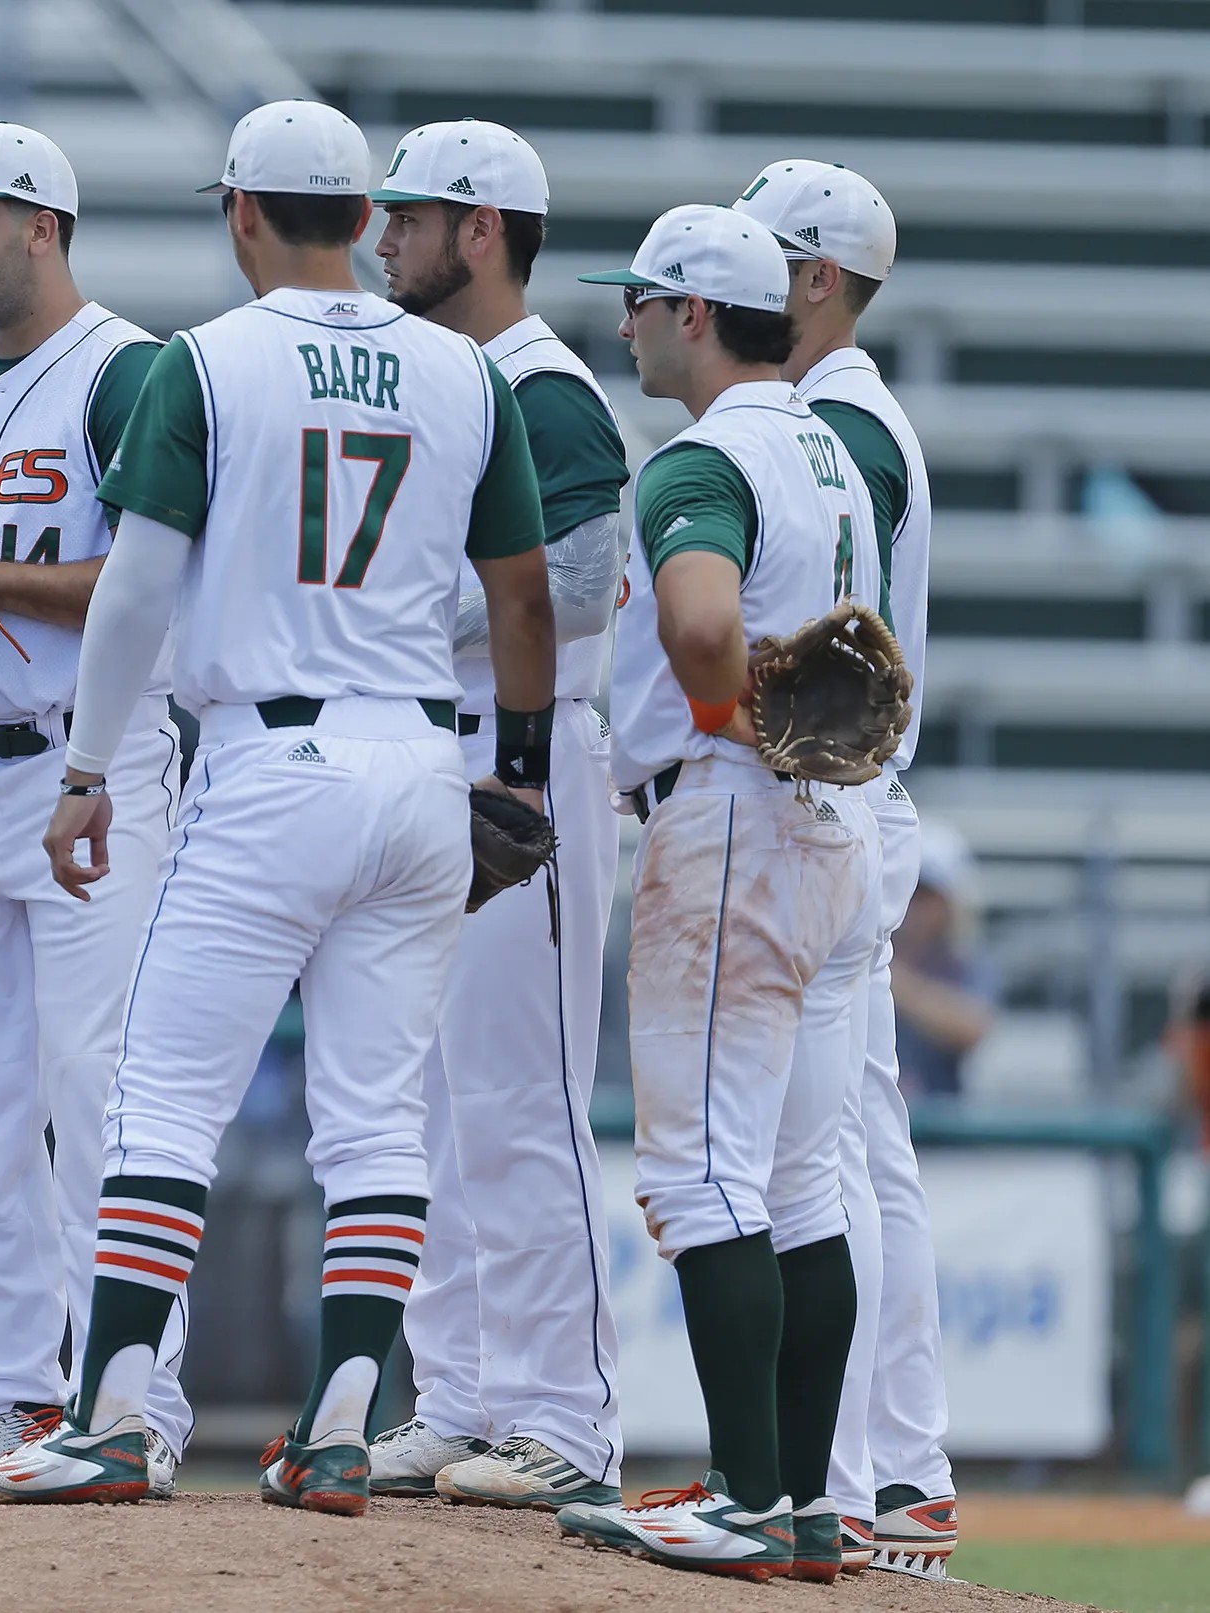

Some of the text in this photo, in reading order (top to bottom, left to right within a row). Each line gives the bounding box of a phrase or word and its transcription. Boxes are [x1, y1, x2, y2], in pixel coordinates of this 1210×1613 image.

[309, 174, 351, 186] miami
[446, 185, 476, 197] adidas
[794, 231, 821, 248] adidas
[661, 270, 686, 283] adidas
[327, 302, 358, 314] ACC
[296, 343, 400, 411] BARR
[297, 427, 412, 589] 17
[286, 752, 327, 764] adidas
[100, 1447, 147, 1468] adizero
